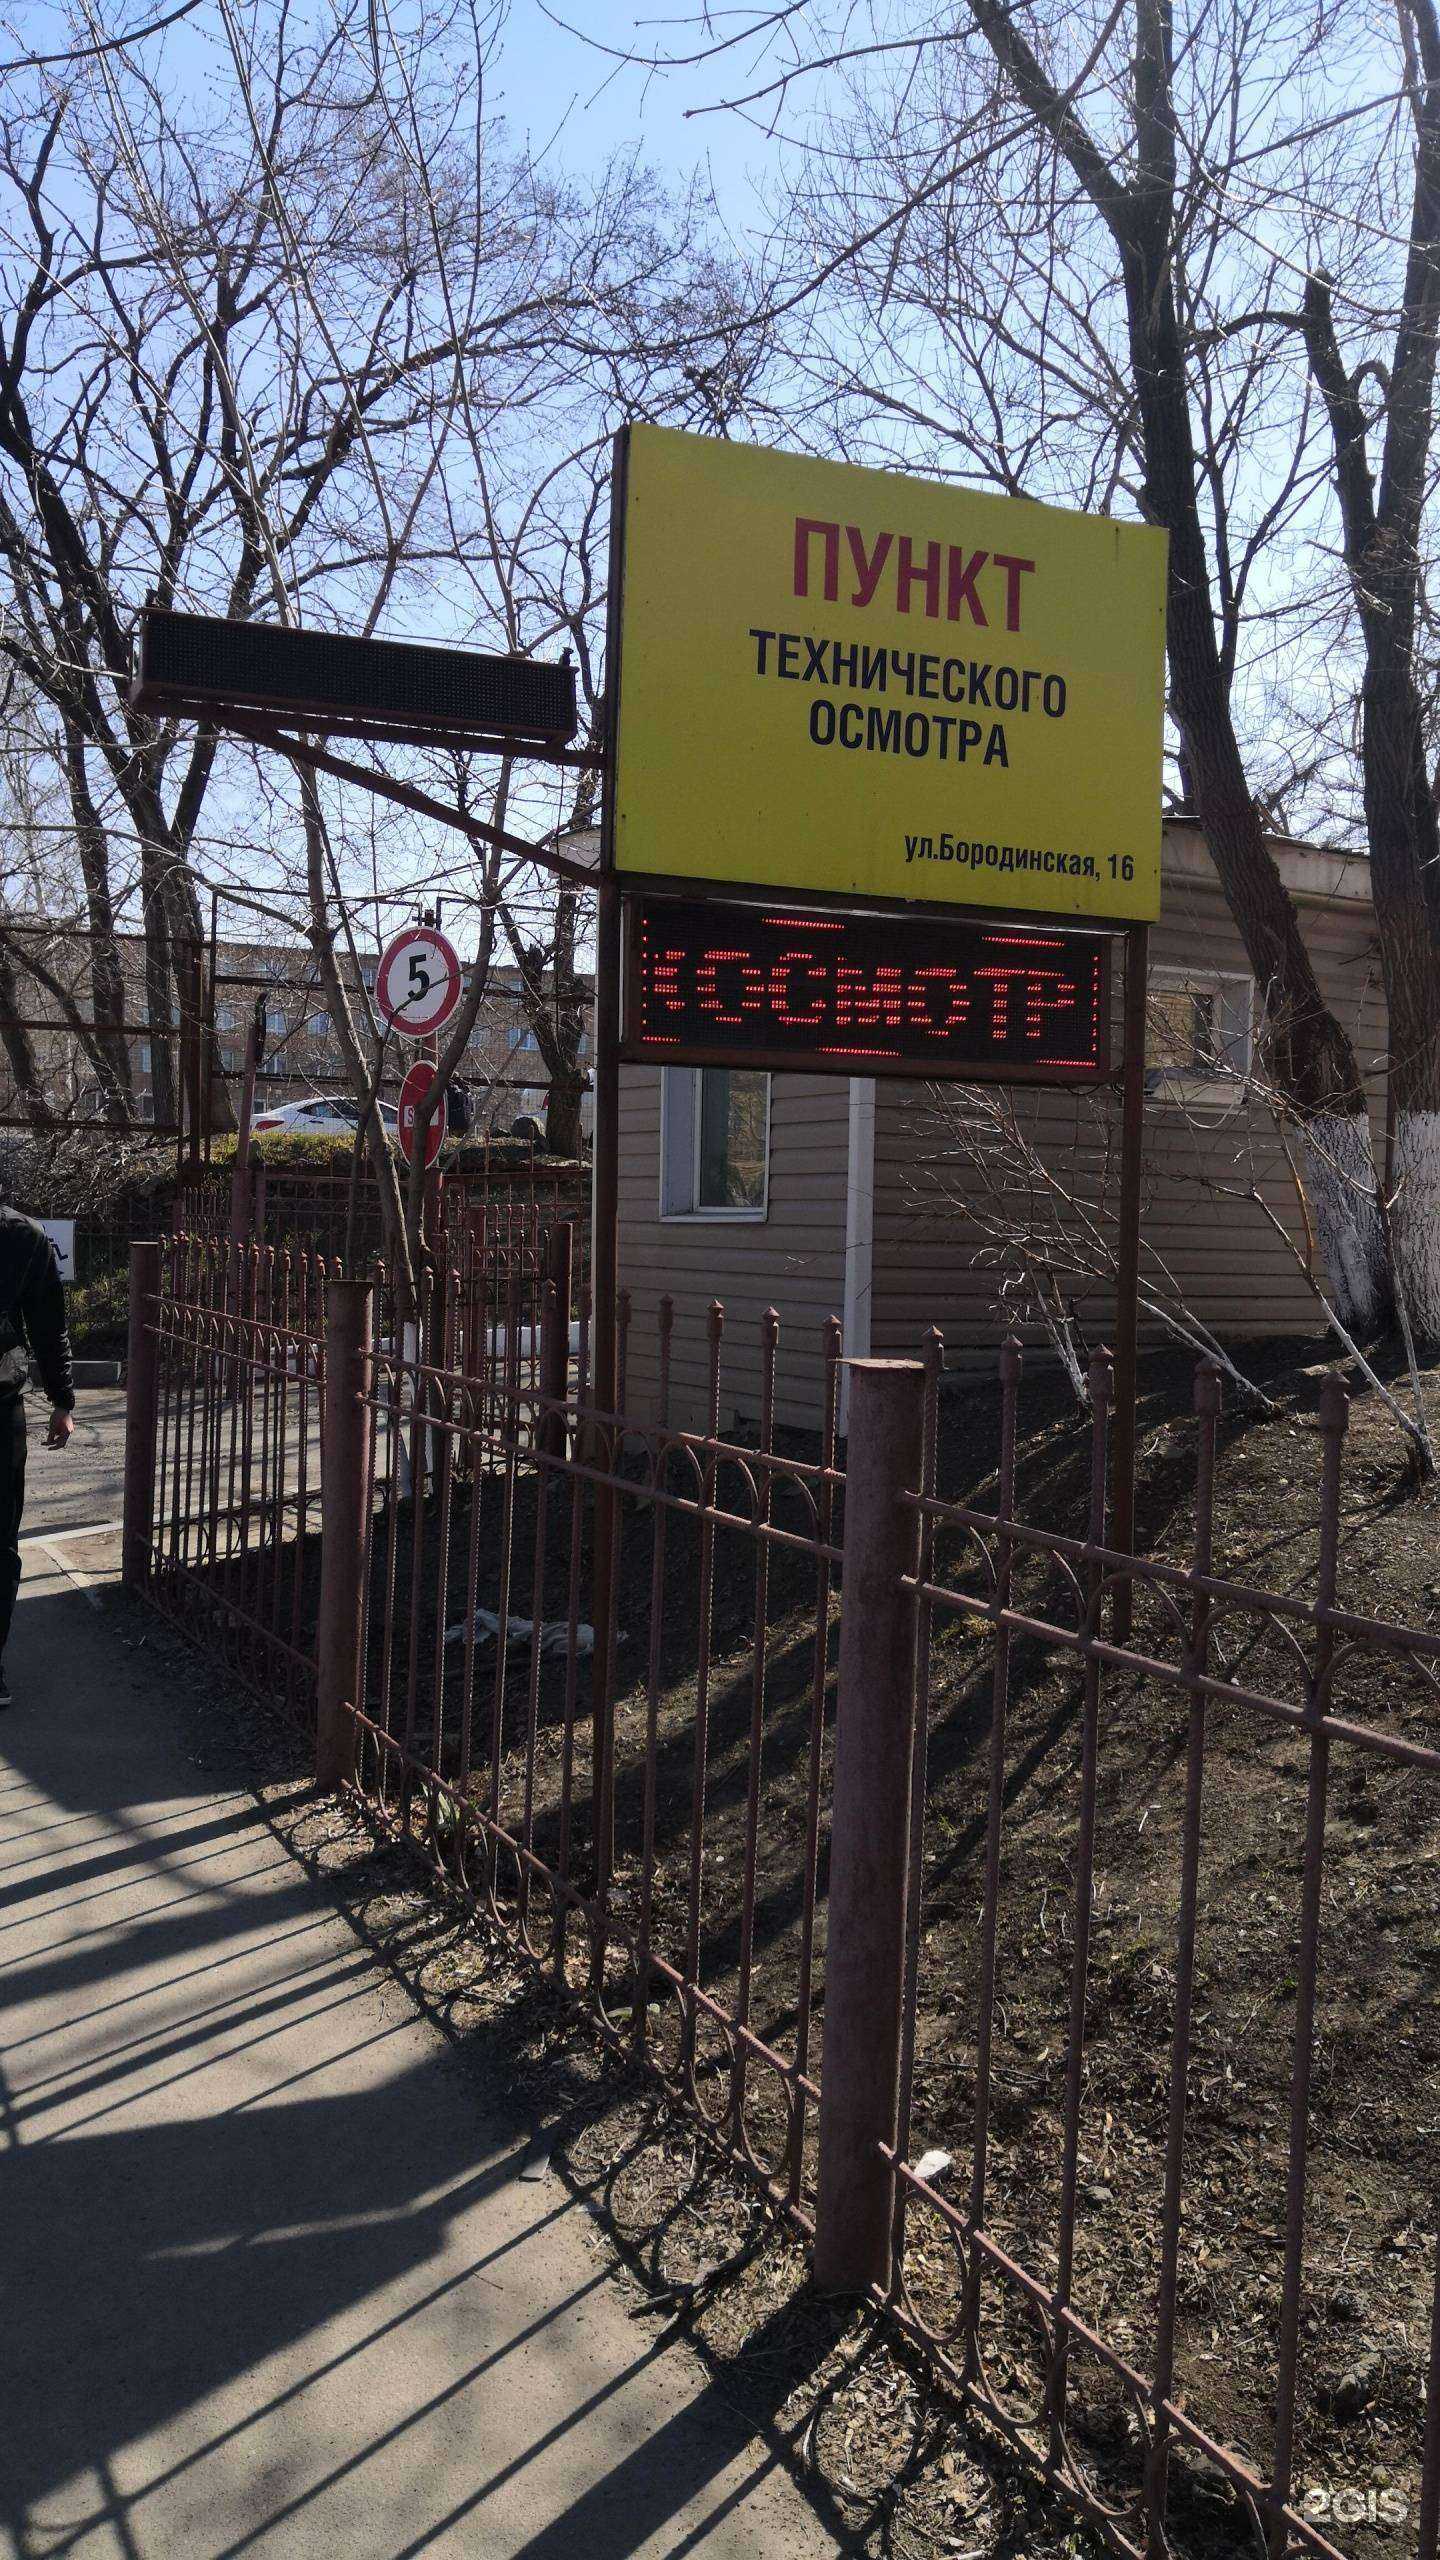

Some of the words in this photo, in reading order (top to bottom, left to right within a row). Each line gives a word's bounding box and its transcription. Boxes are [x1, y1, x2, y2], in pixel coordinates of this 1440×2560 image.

[793, 516, 1037, 632] ПУНКТ
[748, 628, 1068, 718] ТЕХНИЧЕСКОГО
[808, 699, 1010, 768] ОСМОТРА
[1107, 853, 1135, 882] 16
[407, 953, 430, 1002] 5
